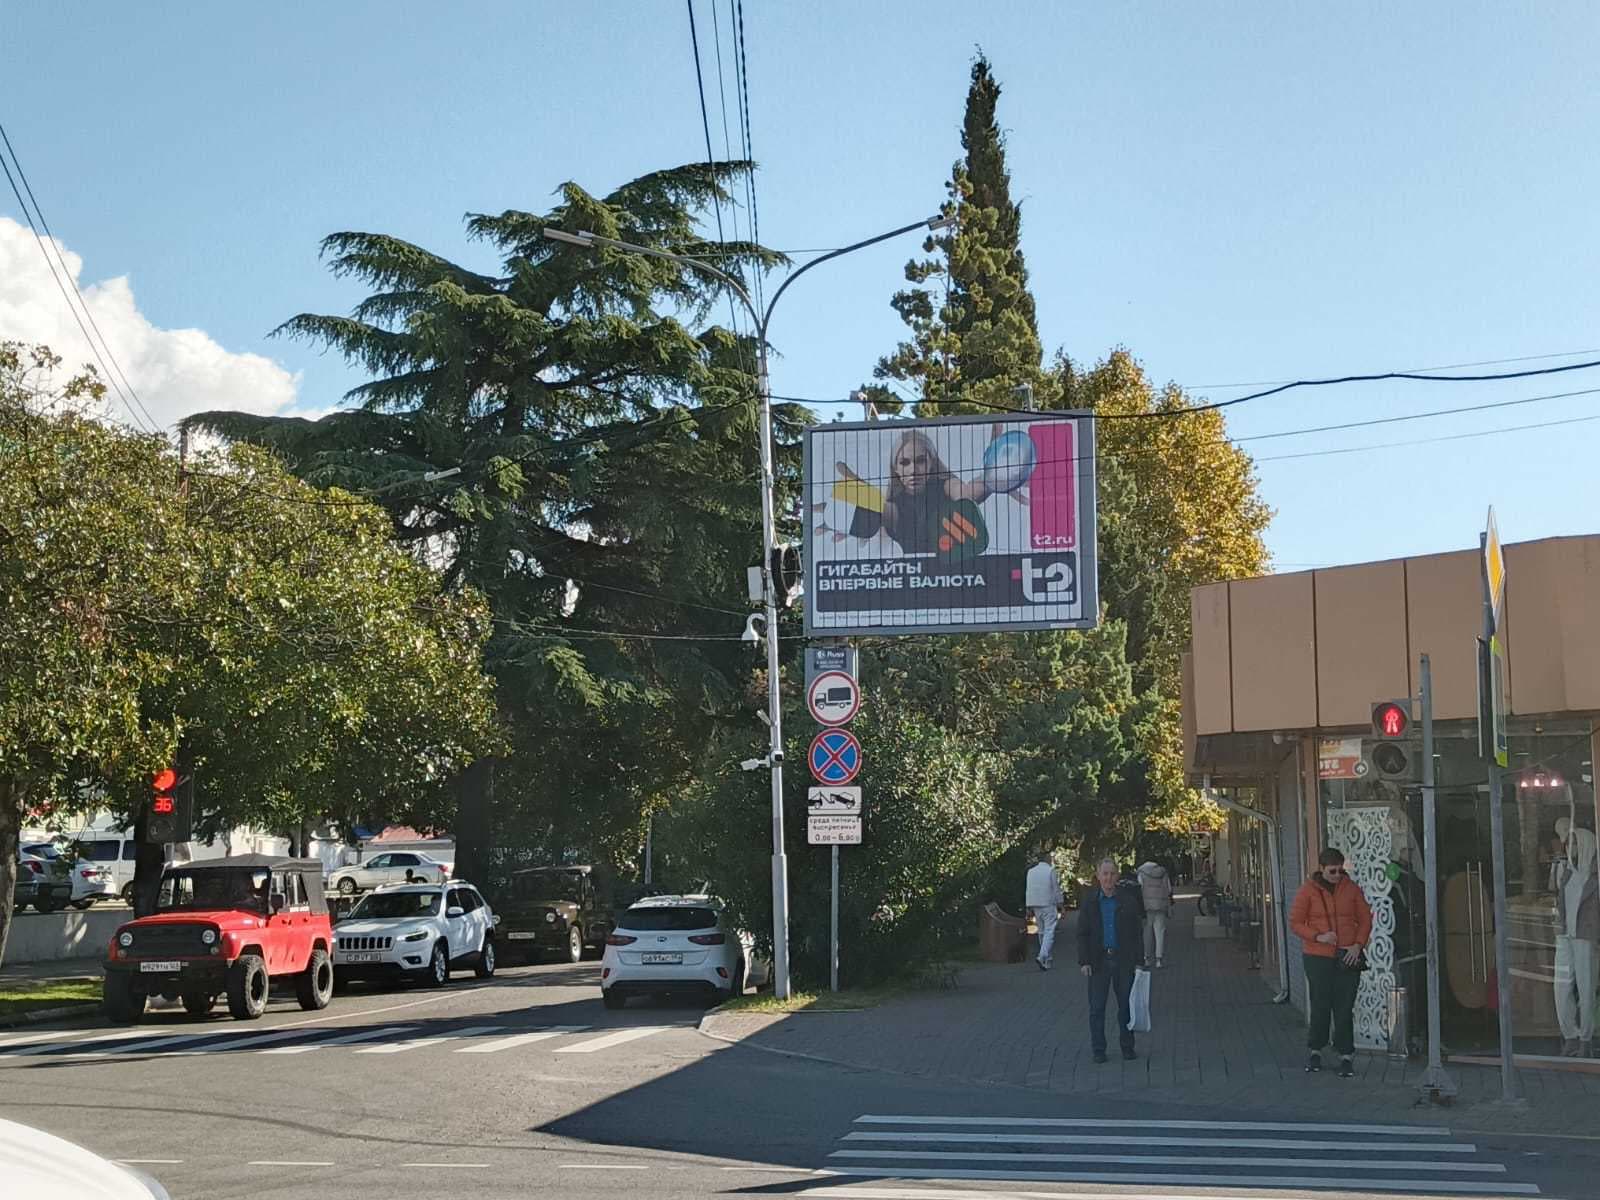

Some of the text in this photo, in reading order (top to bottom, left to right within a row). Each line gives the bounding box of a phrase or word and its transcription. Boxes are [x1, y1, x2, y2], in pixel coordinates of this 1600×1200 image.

[1032, 534, 1073, 546] t2.ru
[818, 559, 922, 577] ГИГАБАЙТЫ
[818, 573, 986, 592] ВПЕРВЫЕ ВАЛЮТА
[1021, 558, 1074, 602] t2
[153, 797, 172, 812] 36
